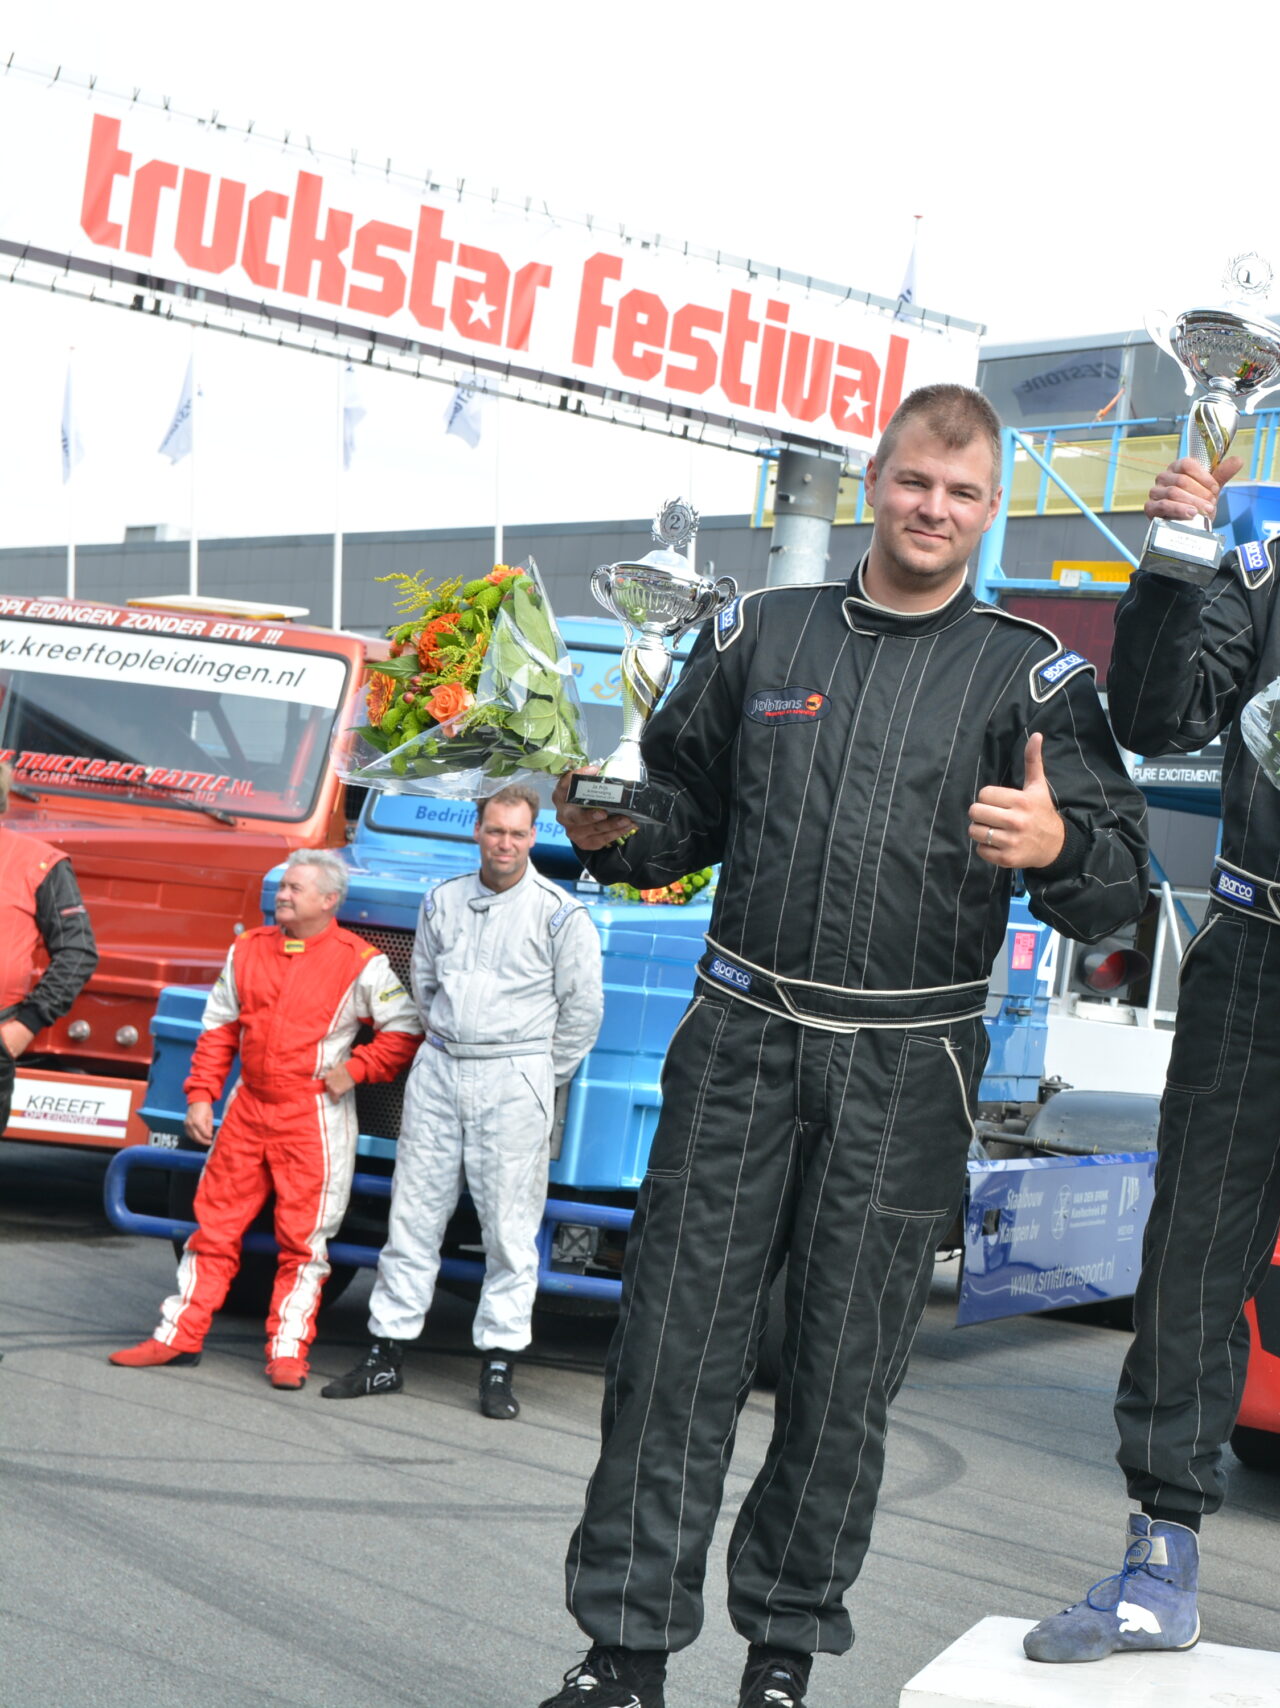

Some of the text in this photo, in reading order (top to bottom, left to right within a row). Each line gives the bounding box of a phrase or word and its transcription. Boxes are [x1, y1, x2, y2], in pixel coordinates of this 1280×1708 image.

[80, 112, 910, 439] truckstar festival
[670, 514, 681, 530] 2
[121, 613, 208, 636] ZONDER
[211, 624, 259, 642] BTW
[1133, 767, 1158, 780] PURE
[415, 805, 478, 828] Bedrijf
[713, 959, 751, 986] sparco
[1036, 927, 1061, 998] 4
[26, 1094, 105, 1116] KREEFT
